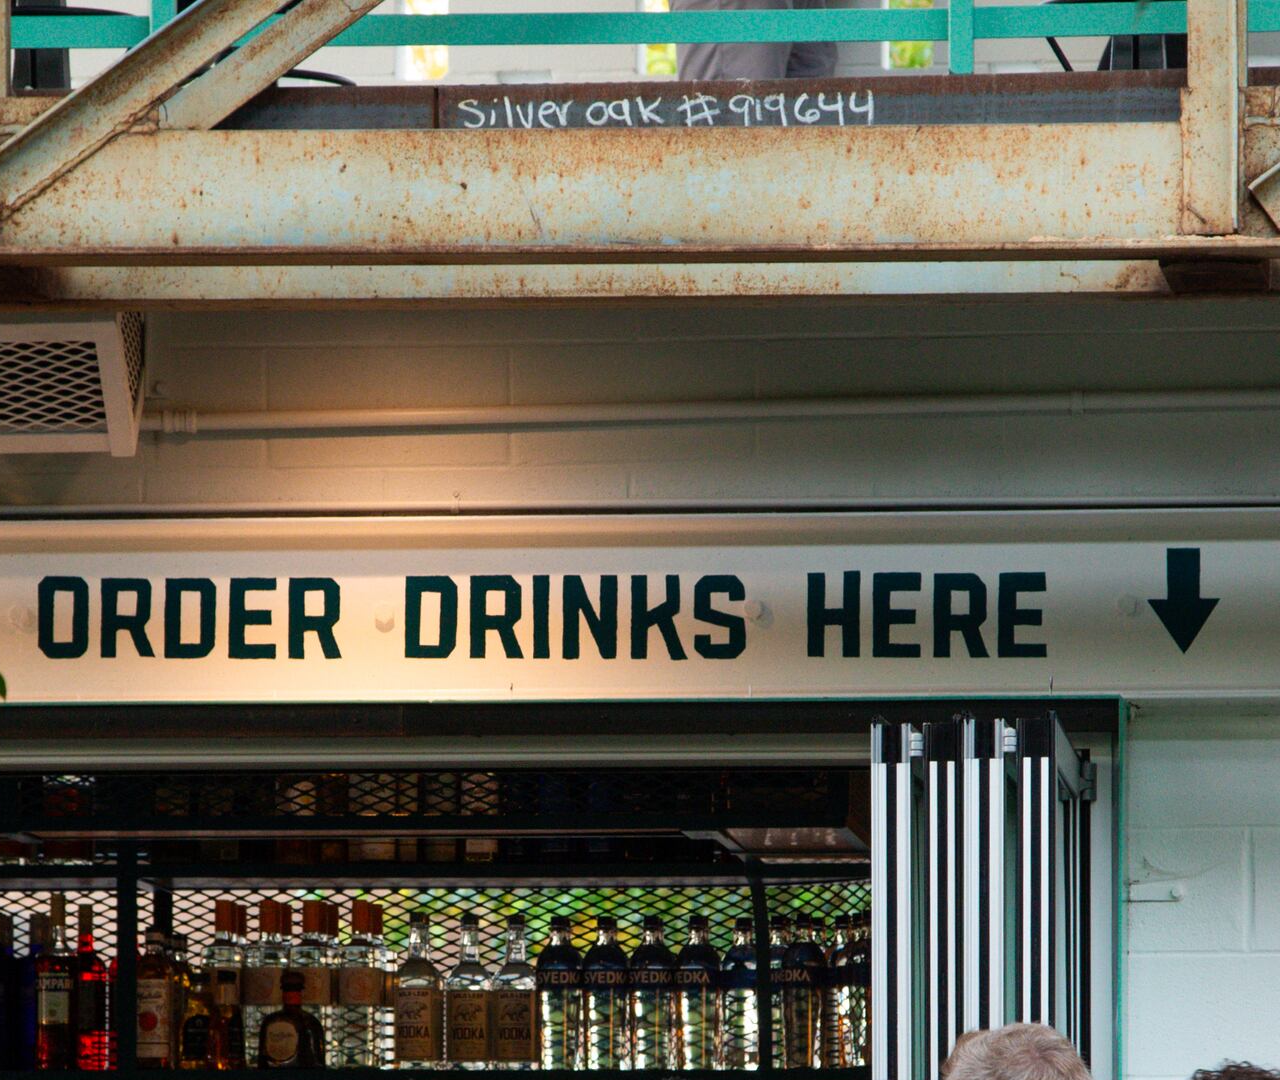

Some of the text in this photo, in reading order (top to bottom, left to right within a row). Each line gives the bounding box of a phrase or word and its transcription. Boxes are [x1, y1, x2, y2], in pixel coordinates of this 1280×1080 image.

[457, 94, 572, 129] Silver
[38, 570, 1048, 661] ORDER DRINKS HERE
